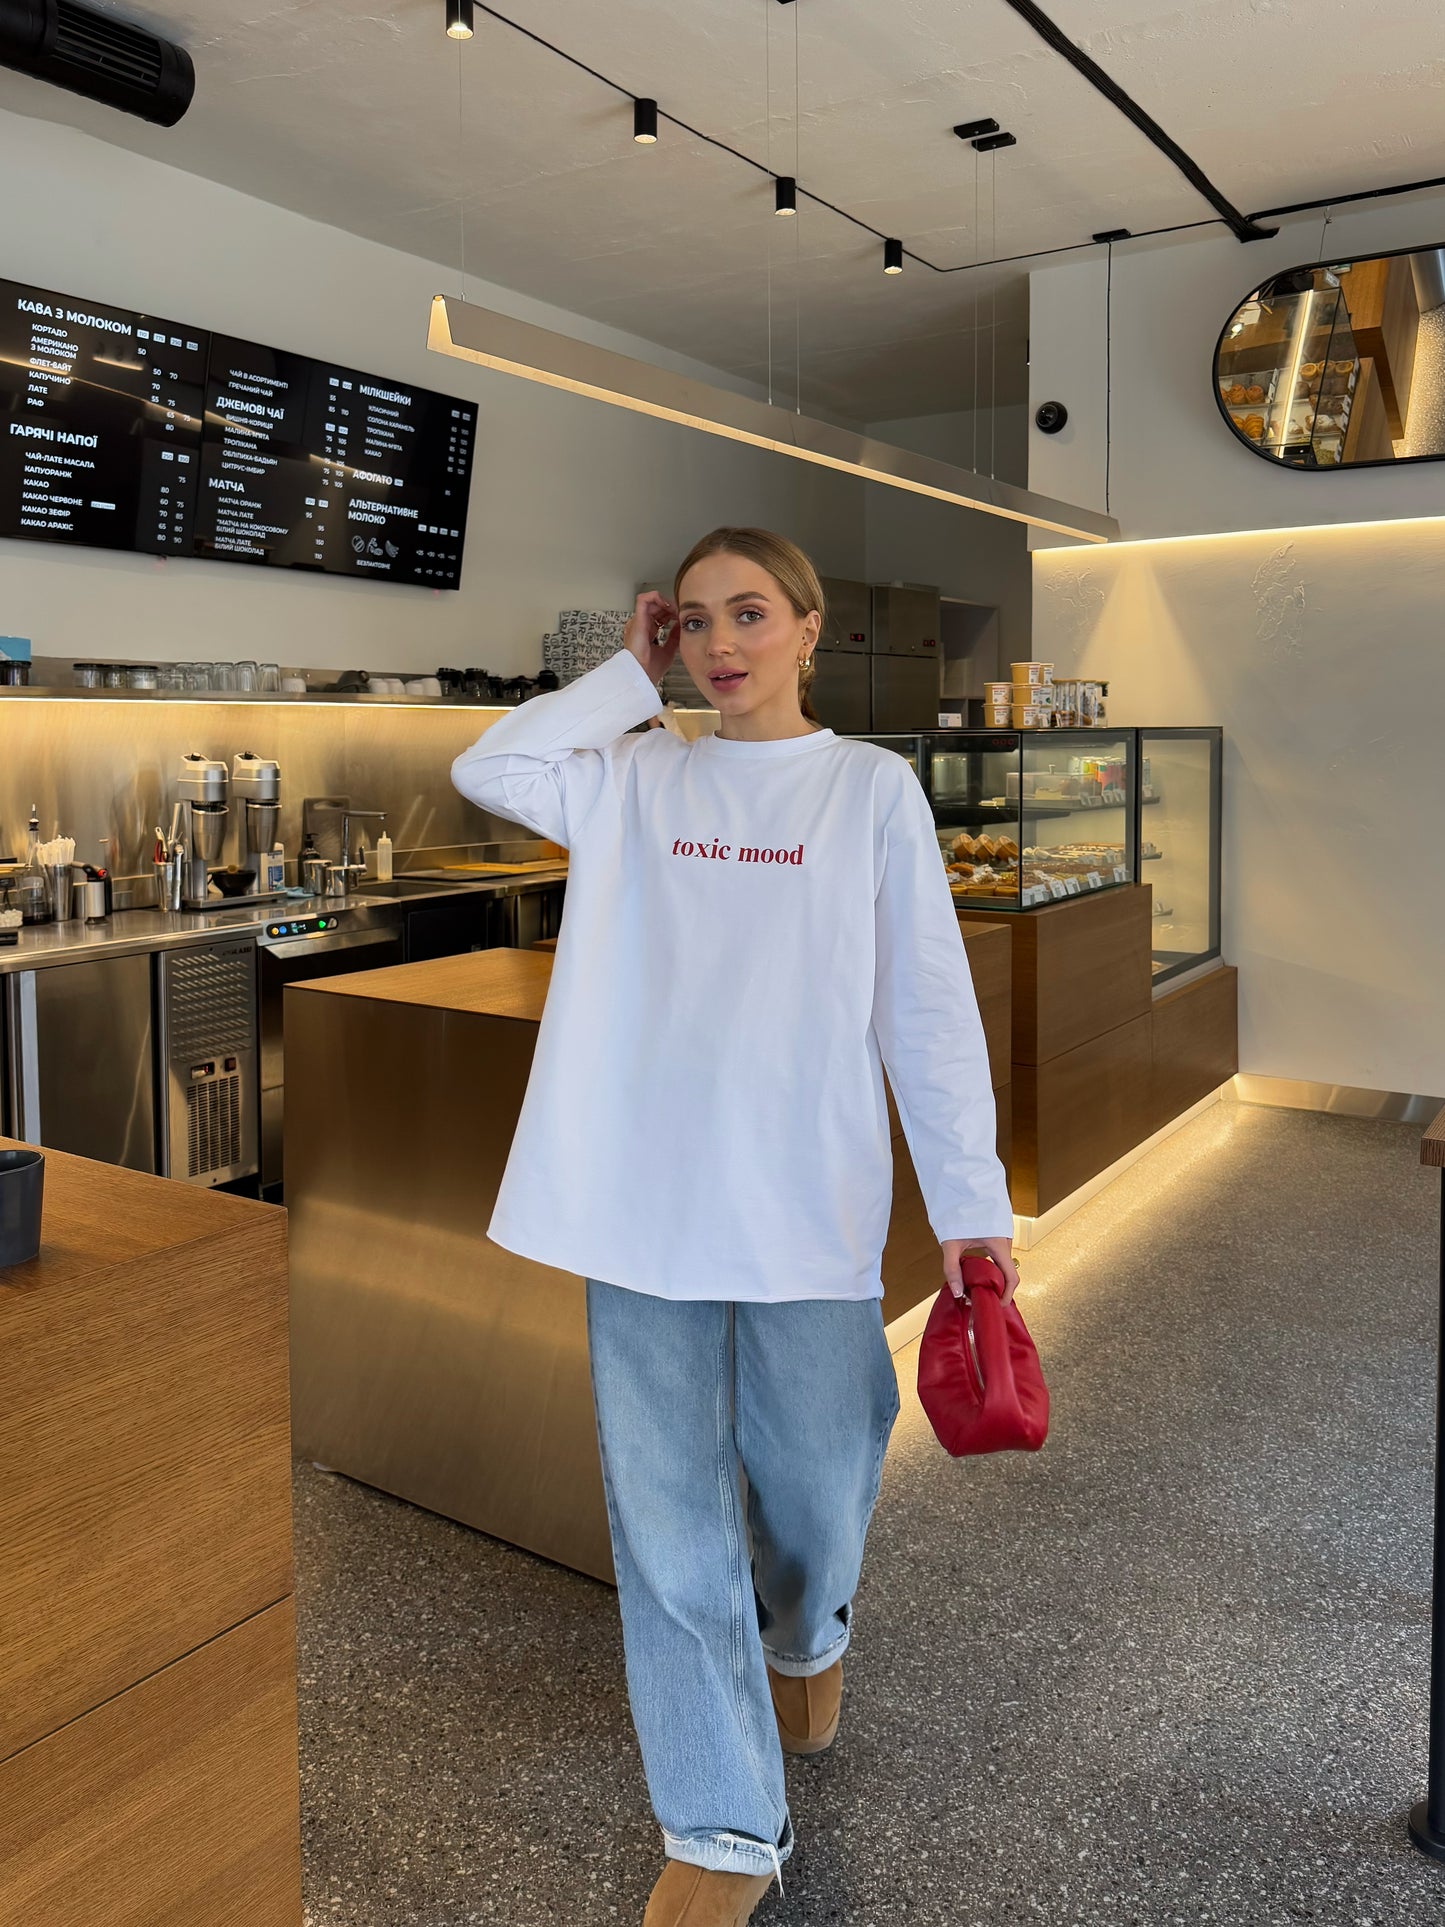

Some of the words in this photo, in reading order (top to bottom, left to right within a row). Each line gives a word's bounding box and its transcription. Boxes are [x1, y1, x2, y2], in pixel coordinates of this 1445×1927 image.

[18, 298, 53, 318] КАВА
[55, 308, 64, 320] З
[66, 310, 132, 336] МОЛОКОМ
[32, 323, 67, 338] КОРТАДО
[31, 335, 79, 353] АМЕРИКАНО
[37, 345, 77, 360] МОЛОКОМ
[138, 348, 146, 356] 50
[30, 356, 72, 372] ФЛЕТ-ВАЙТ
[29, 371, 71, 386] КАПУЧИНО
[153, 368, 162, 376] 50
[170, 372, 178, 380] 70
[229, 369, 244, 379] ЧАЙ
[28, 384, 48, 395] ЛАТЕ
[152, 383, 161, 391] 70
[228, 381, 259, 394] ГРЕЧАНИЙ
[260, 388, 273, 397] ЧАЙ
[151, 396, 160, 404] 55
[359, 383, 412, 406] МІЛКШЕЙКИ
[27, 398, 44, 407] РАФ
[216, 396, 265, 417] ДЖЕМОВІ
[267, 406, 284, 420] ЧАЇ
[10, 423, 55, 441] ГАРЯЧІ
[57, 429, 98, 449] НАПОЇ
[26, 452, 62, 464] ЧАЙ-ЛАТЕ
[64, 458, 95, 469] МАСАЛА
[365, 449, 382, 458] КАКАО
[25, 465, 72, 479] КАПУОРАНЖ
[353, 469, 393, 485] АФОГАТО
[24, 478, 50, 488] КАКАО
[208, 478, 245, 493] МАТЧА
[23, 492, 48, 502] КАКАО
[49, 495, 83, 506] ЧЕРВОНЕ
[219, 497, 239, 505] МАТЧА
[22, 505, 47, 515] КАКАО
[48, 509, 71, 518] ЗЕФІР
[218, 509, 238, 517] МАТЧА
[239, 512, 254, 520] ЛАТЕ
[349, 498, 418, 519] АЛЬТЕРНАТИВНЕ
[21, 518, 46, 528] КАКАО
[48, 522, 73, 531] АРАХІС
[348, 511, 386, 525] МОЛОКО
[233, 528, 266, 539] ШОКОЛАД
[250, 524, 288, 535] КОКОСОВОМУ
[216, 536, 235, 544] МАТЧА
[232, 545, 264, 555] ШОКОЛАД
[672, 837, 731, 860] toxic
[738, 845, 804, 865] mood
